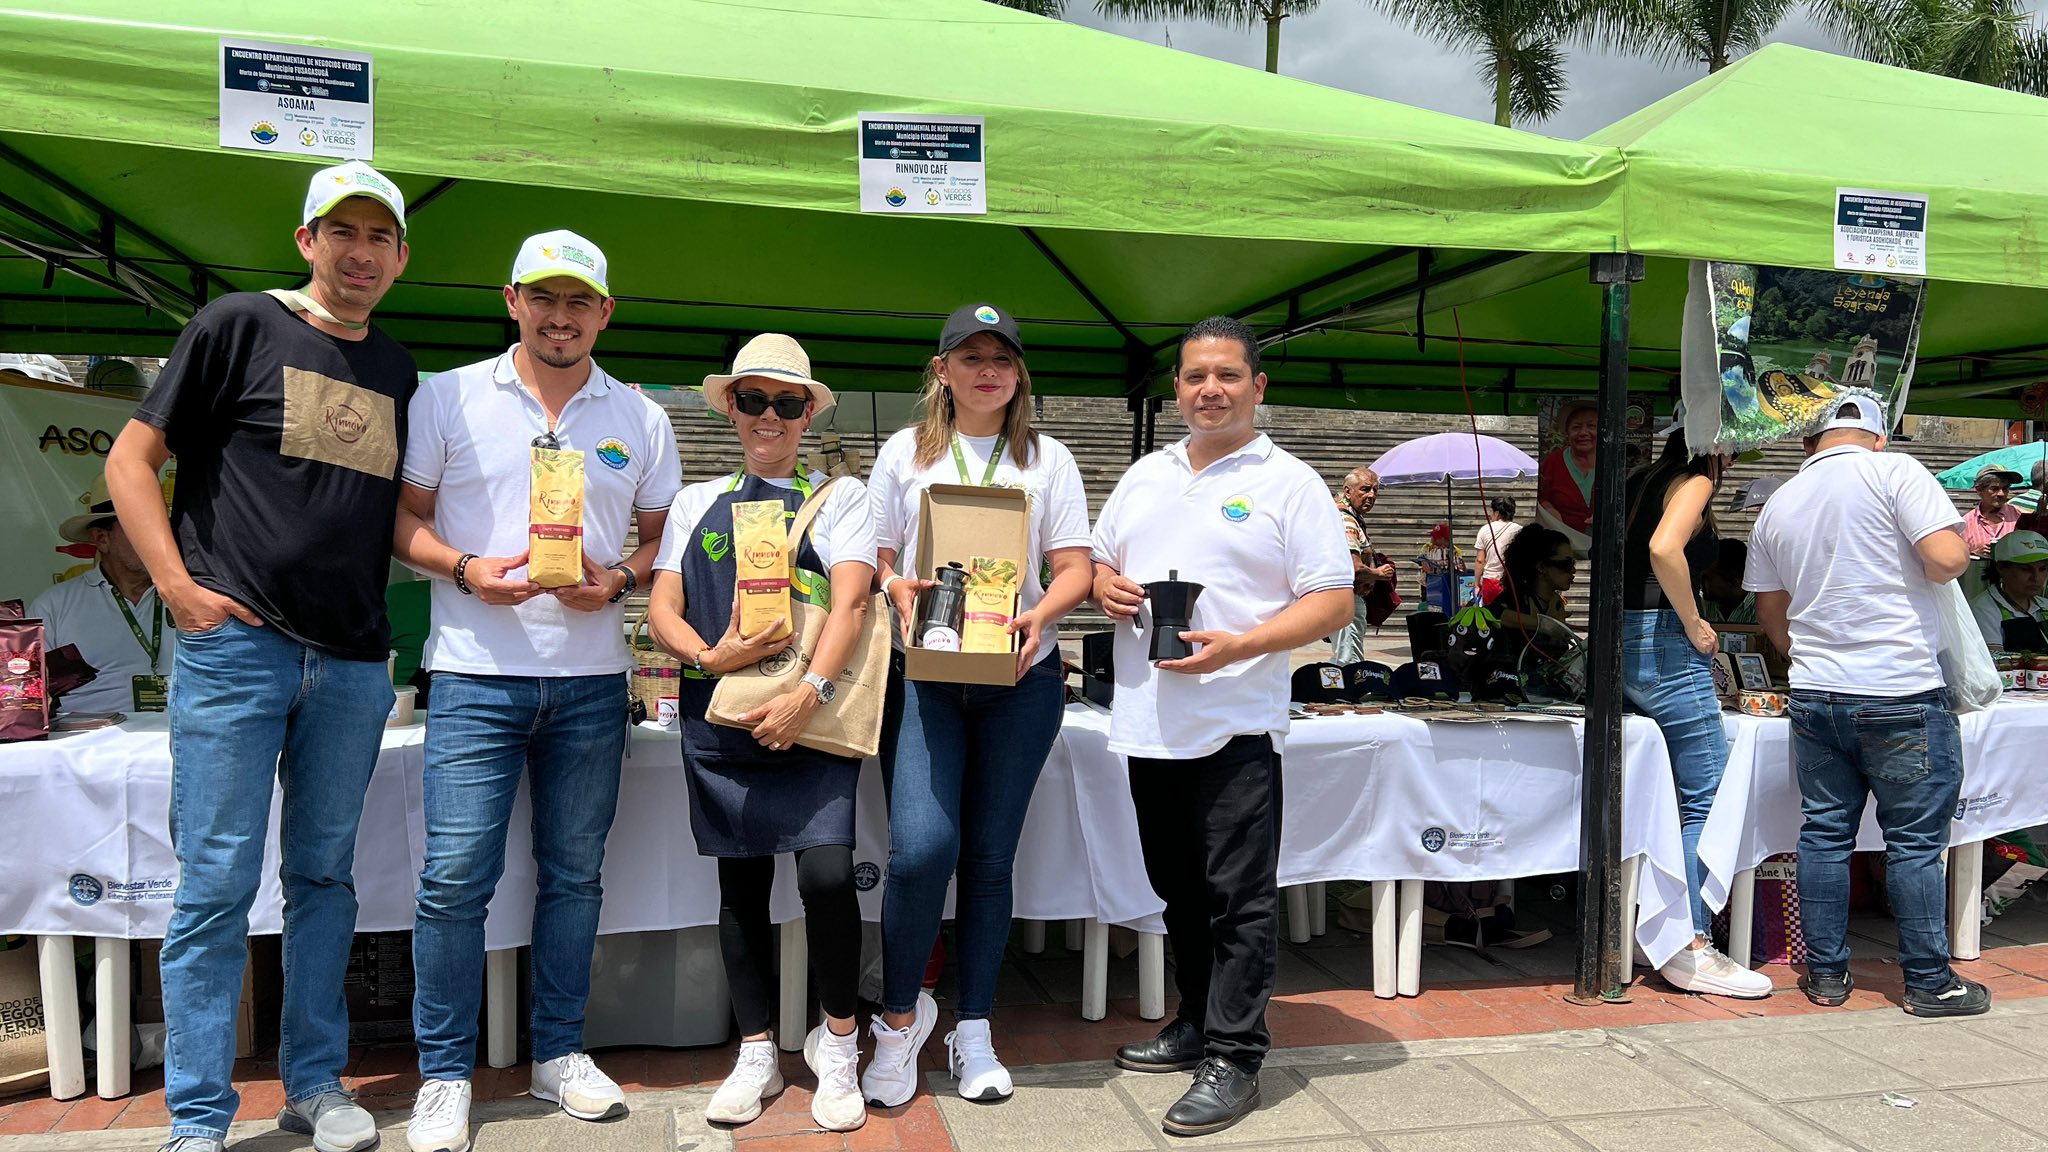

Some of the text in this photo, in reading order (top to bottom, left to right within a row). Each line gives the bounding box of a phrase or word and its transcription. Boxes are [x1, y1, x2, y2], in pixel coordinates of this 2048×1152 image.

[232, 50, 362, 71] ENCUENTRO DEPARTAMENTAL DE NEGOCIOS VERDES
[265, 63, 294, 73] Municipio
[277, 97, 316, 111] ASOAMA
[868, 122, 894, 130] ENCUENTRO
[322, 129, 356, 137] NEGOCIOS
[322, 136, 356, 146] VERDES
[895, 162, 948, 174] RINNOVO CAFÉ
[944, 193, 972, 201] VERDES
[1837, 284, 1890, 301] Leyenda
[1833, 297, 1887, 313] Sagrada
[325, 406, 367, 433] Rinnovo
[39, 425, 114, 458] ASO
[1755, 865, 1797, 878] eline He
[107, 879, 172, 890] Bienestar Verde
[0, 996, 40, 1011] ODO DE
[0, 1004, 44, 1023] EGOC
